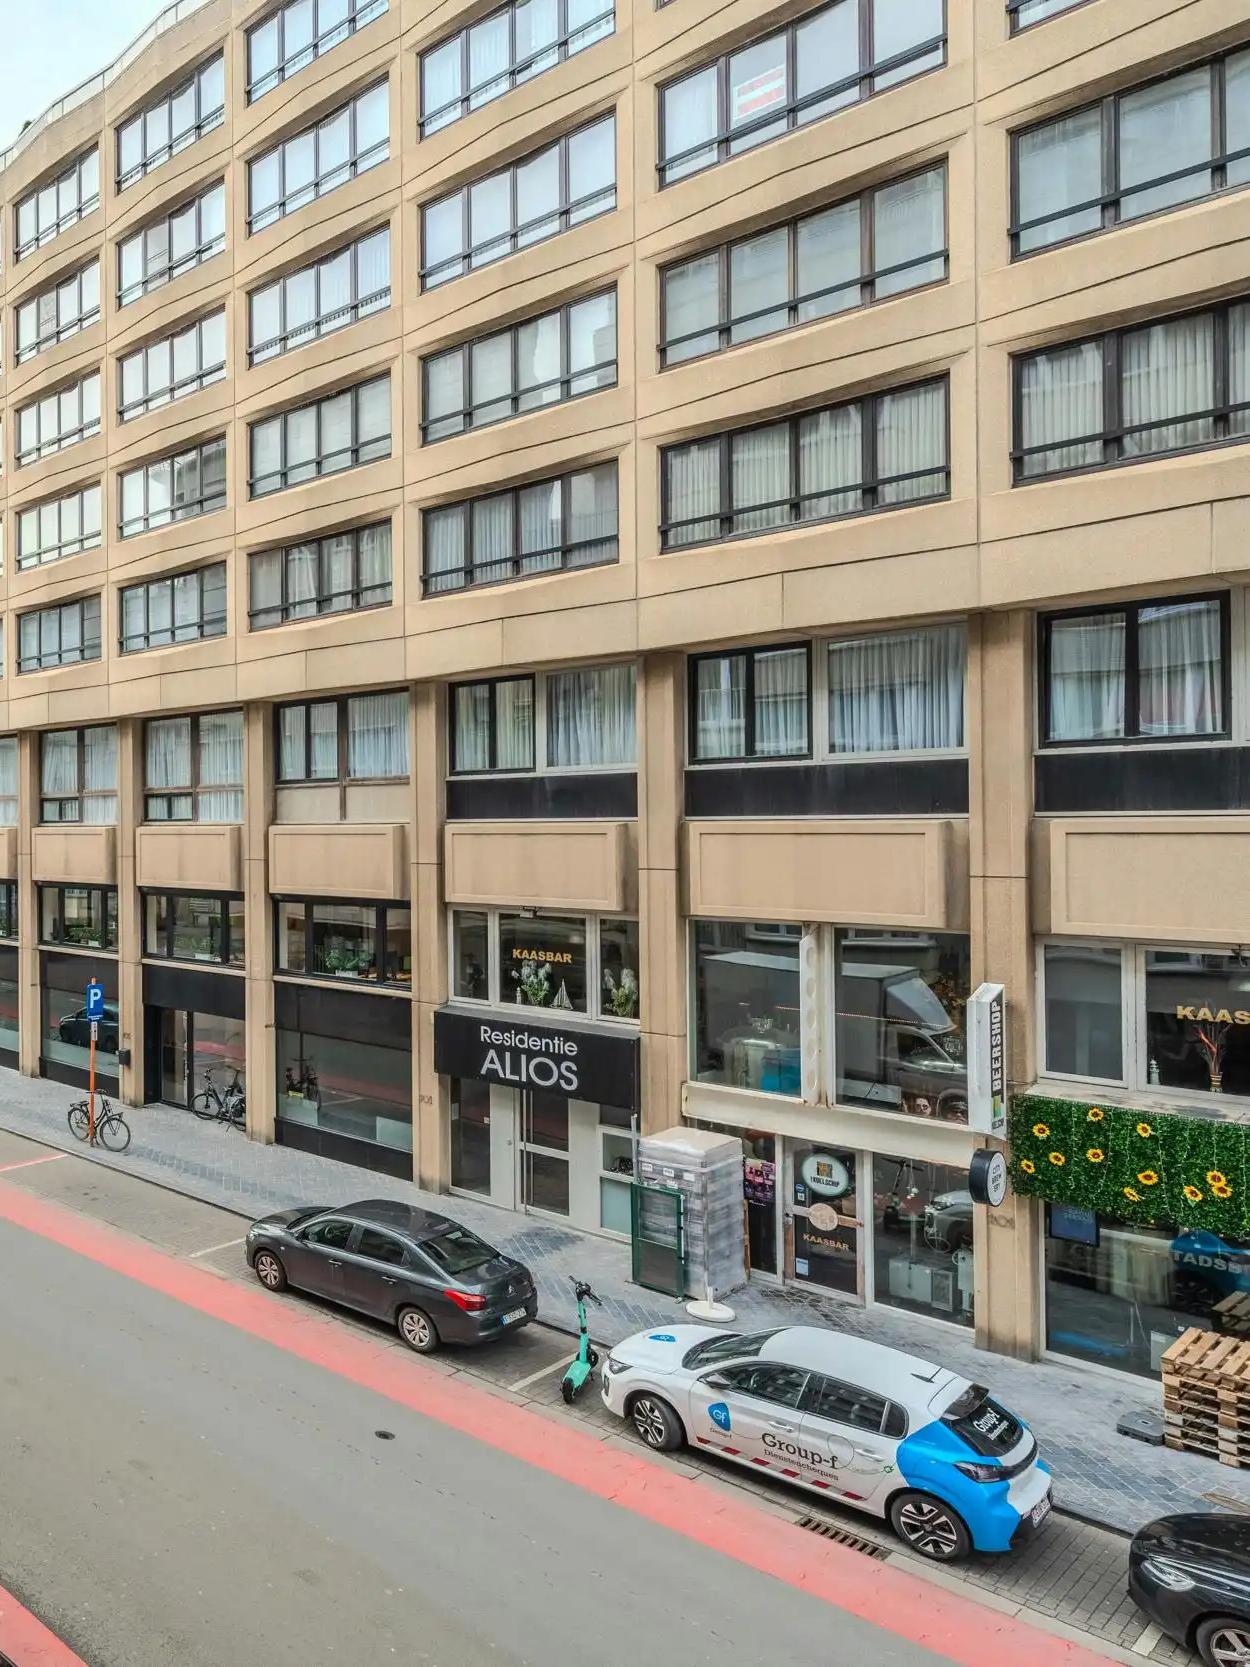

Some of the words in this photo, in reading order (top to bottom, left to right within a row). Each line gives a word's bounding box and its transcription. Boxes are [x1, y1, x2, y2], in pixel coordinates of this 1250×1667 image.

[512, 948, 572, 964] KAASBAR
[90, 988, 102, 1009] P
[480, 1025, 578, 1056] Residentie
[990, 1000, 1002, 1092] BEERSHOP
[480, 1048, 579, 1091] ALIOS
[802, 1232, 850, 1251] KAASBAR
[761, 1432, 839, 1470] Group-f
[764, 1448, 839, 1481] Dienstencheques
